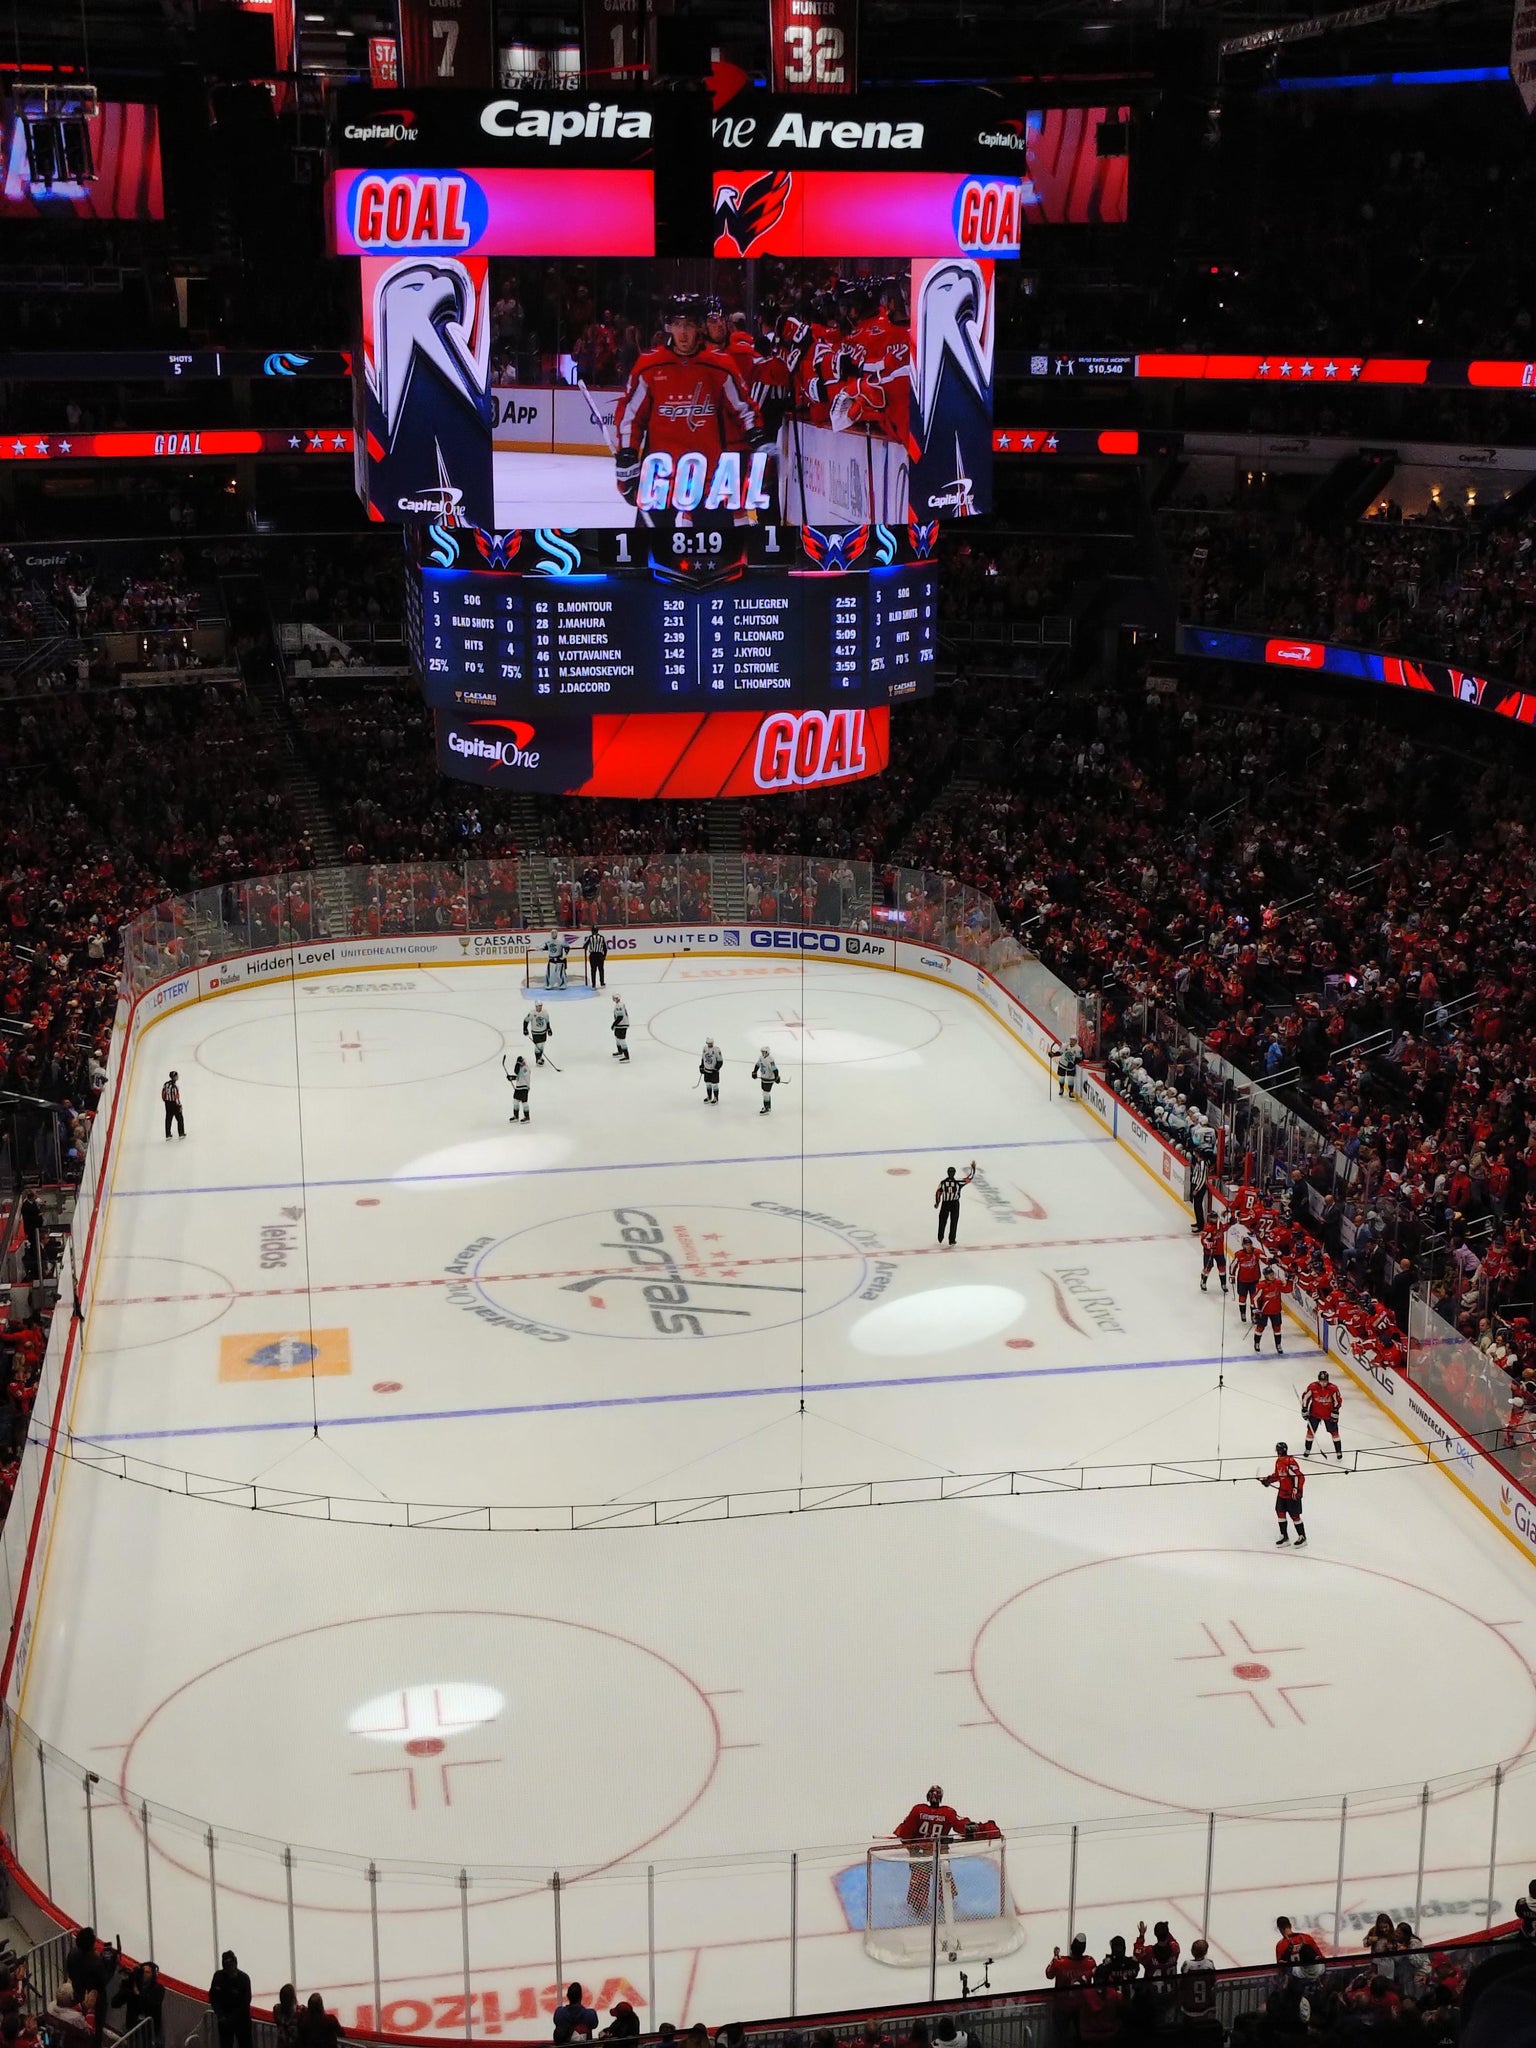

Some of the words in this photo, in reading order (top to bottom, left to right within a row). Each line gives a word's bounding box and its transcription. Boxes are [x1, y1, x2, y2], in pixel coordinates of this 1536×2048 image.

[792, 1, 835, 15] HUNTER
[432, 20, 459, 77] 7
[610, 24, 649, 80] 11
[784, 26, 844, 83] 32
[767, 113, 924, 148] Arena
[355, 177, 471, 248] GOAL
[169, 355, 193, 363] SHOTS
[175, 364, 182, 375] 5
[1088, 365, 1123, 375] $10,540
[154, 435, 202, 454] GOAL
[636, 452, 771, 511] GOAL
[616, 533, 632, 562] 1
[672, 532, 722, 554] 8:19
[764, 525, 780, 553] 1
[433, 591, 440, 604] 5
[463, 594, 481, 606] SOG
[506, 597, 513, 610] 3
[535, 602, 549, 613] 62
[557, 601, 613, 613] B.MONTOUR
[663, 600, 685, 611] 5:20
[711, 599, 724, 610] 27
[734, 598, 789, 610] T.LILJEGREN
[836, 597, 857, 608] 2:52
[434, 614, 440, 627] 3
[452, 616, 471, 627] BLKD
[472, 617, 495, 630] SHOTS
[506, 620, 514, 633] 0
[536, 618, 549, 629] 28
[557, 617, 606, 629] J.MAHURA
[663, 616, 685, 627] 2:31
[711, 615, 724, 626] 44
[733, 614, 779, 626] C.HUTSON
[836, 613, 857, 624] 3:19
[537, 635, 549, 645] 10
[558, 634, 609, 645] M.BENIERS
[663, 632, 685, 643] 2:39
[714, 631, 721, 642] 9
[734, 630, 785, 642] R.LEONARD
[835, 629, 857, 640] 5:09
[435, 636, 442, 649] 2
[464, 639, 484, 651] HITS
[507, 642, 515, 656] 4
[536, 651, 550, 661] 46
[558, 649, 622, 661] V.OTTAVAINEN
[664, 648, 685, 659] 1:42
[711, 647, 724, 658] 25
[733, 646, 771, 657] J.KYROU
[835, 645, 857, 656] 4:17
[429, 658, 449, 672] 25%
[465, 662, 476, 672] FO
[501, 664, 522, 679] 75%
[538, 667, 550, 678] 11
[559, 665, 634, 677] M.SAMOSKEVICH
[664, 664, 686, 675] 1:36
[712, 663, 724, 674] 17
[734, 662, 780, 674] D.STROME
[835, 661, 857, 672] 3:59
[538, 683, 551, 694] 35
[559, 682, 611, 694] J.DACCORD
[671, 680, 679, 691] G
[711, 679, 725, 690] 48
[734, 677, 791, 690] L.THOMPSON
[842, 676, 850, 687] G
[754, 709, 866, 789] GOAL
[474, 935, 531, 946] CAESARS
[653, 934, 719, 944] UNITED
[750, 931, 841, 952] GEICO
[408, 945, 438, 954] GROUP
[247, 957, 293, 975] Hidden
[299, 949, 335, 965] Level
[153, 981, 189, 1008] LOTTERY
[1086, 1083, 1107, 1118] TikTok
[1131, 1121, 1149, 1143] GDIT
[444, 1236, 496, 1275] Arena
[859, 1260, 898, 1301] Arena
[1054, 1267, 1107, 1294] Red
[1078, 1297, 1127, 1334] River
[1408, 1397, 1446, 1440] THUNDERCAT
[919, 1822, 943, 1838] 48
